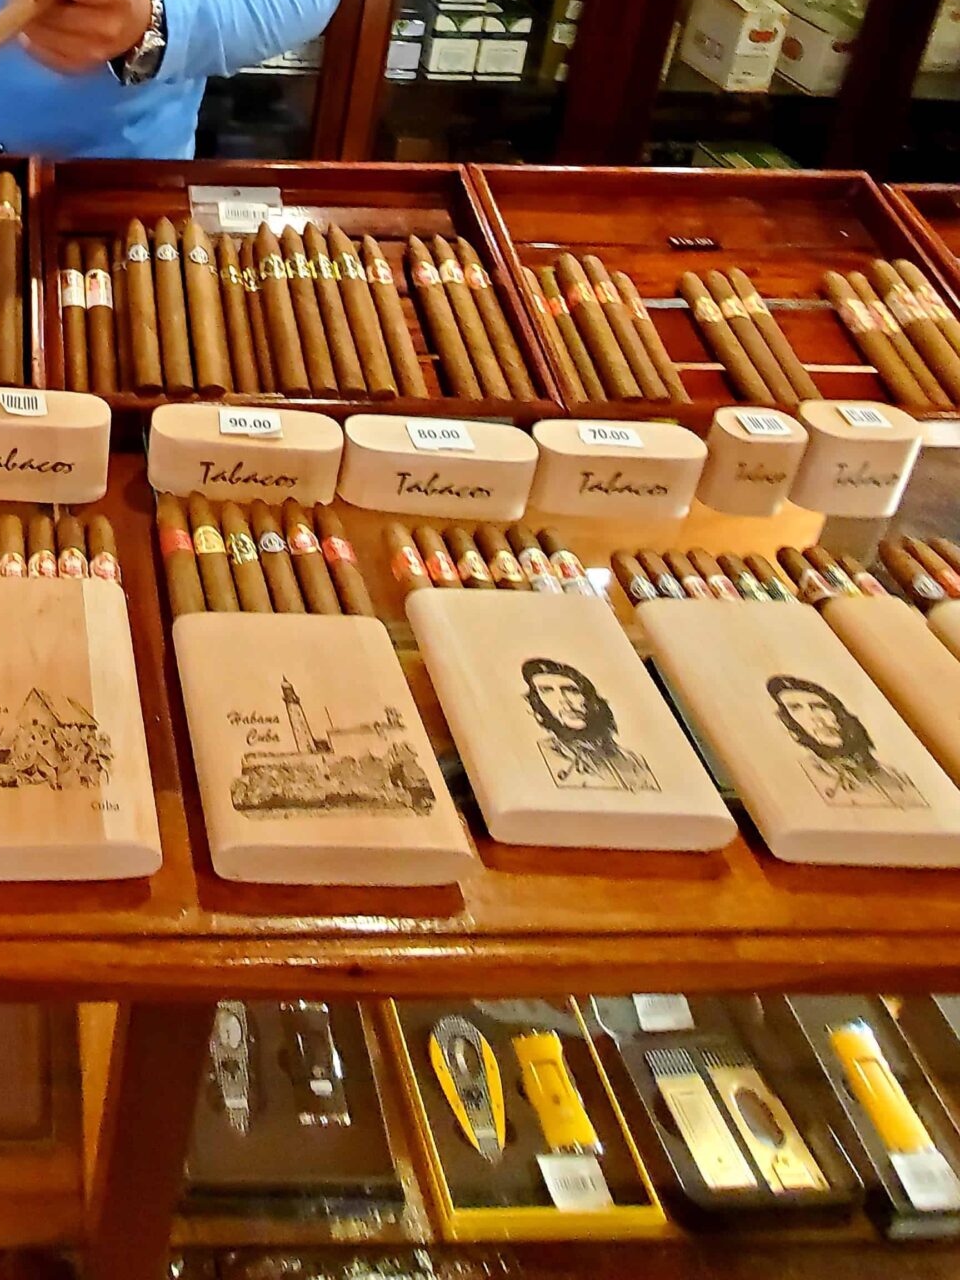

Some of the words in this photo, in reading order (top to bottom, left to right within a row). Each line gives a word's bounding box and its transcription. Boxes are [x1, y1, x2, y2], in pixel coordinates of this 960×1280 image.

[228, 417, 272, 430] 90.00
[417, 428, 460, 440] 80.00
[588, 428, 630, 441] 70.00
[199, 461, 298, 488] Tabacos
